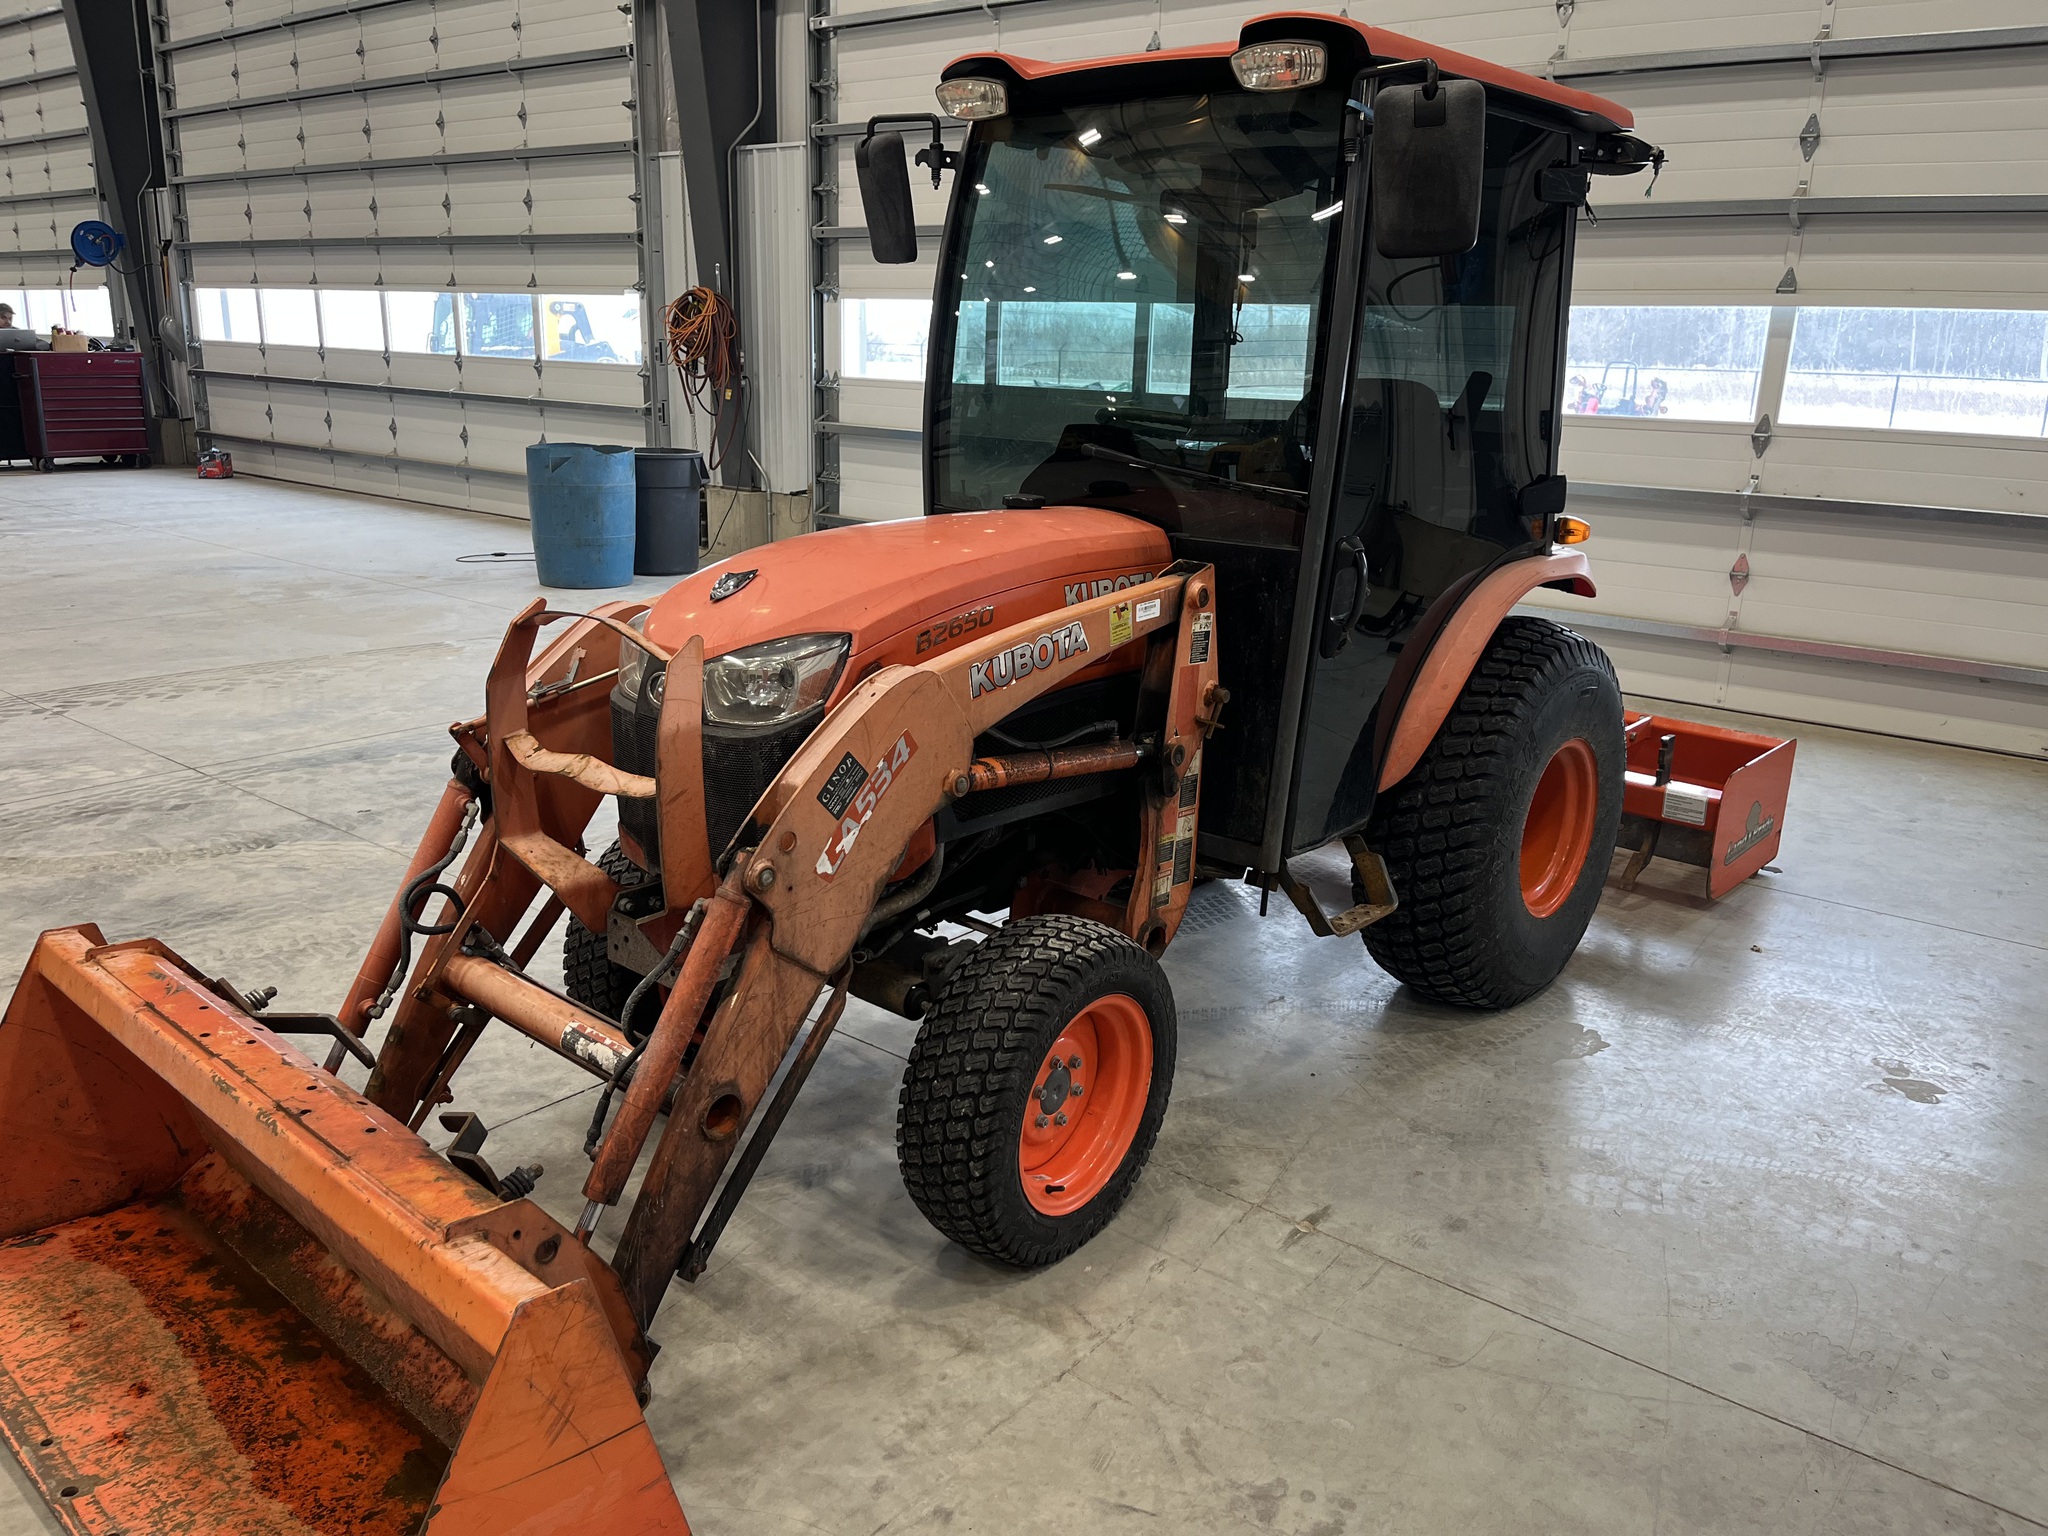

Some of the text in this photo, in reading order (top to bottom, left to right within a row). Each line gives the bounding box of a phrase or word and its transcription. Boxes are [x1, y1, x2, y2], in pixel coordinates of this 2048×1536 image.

[916, 605, 994, 655] B2650
[969, 622, 1088, 699] KUBOTA
[821, 757, 853, 803] GINOP
